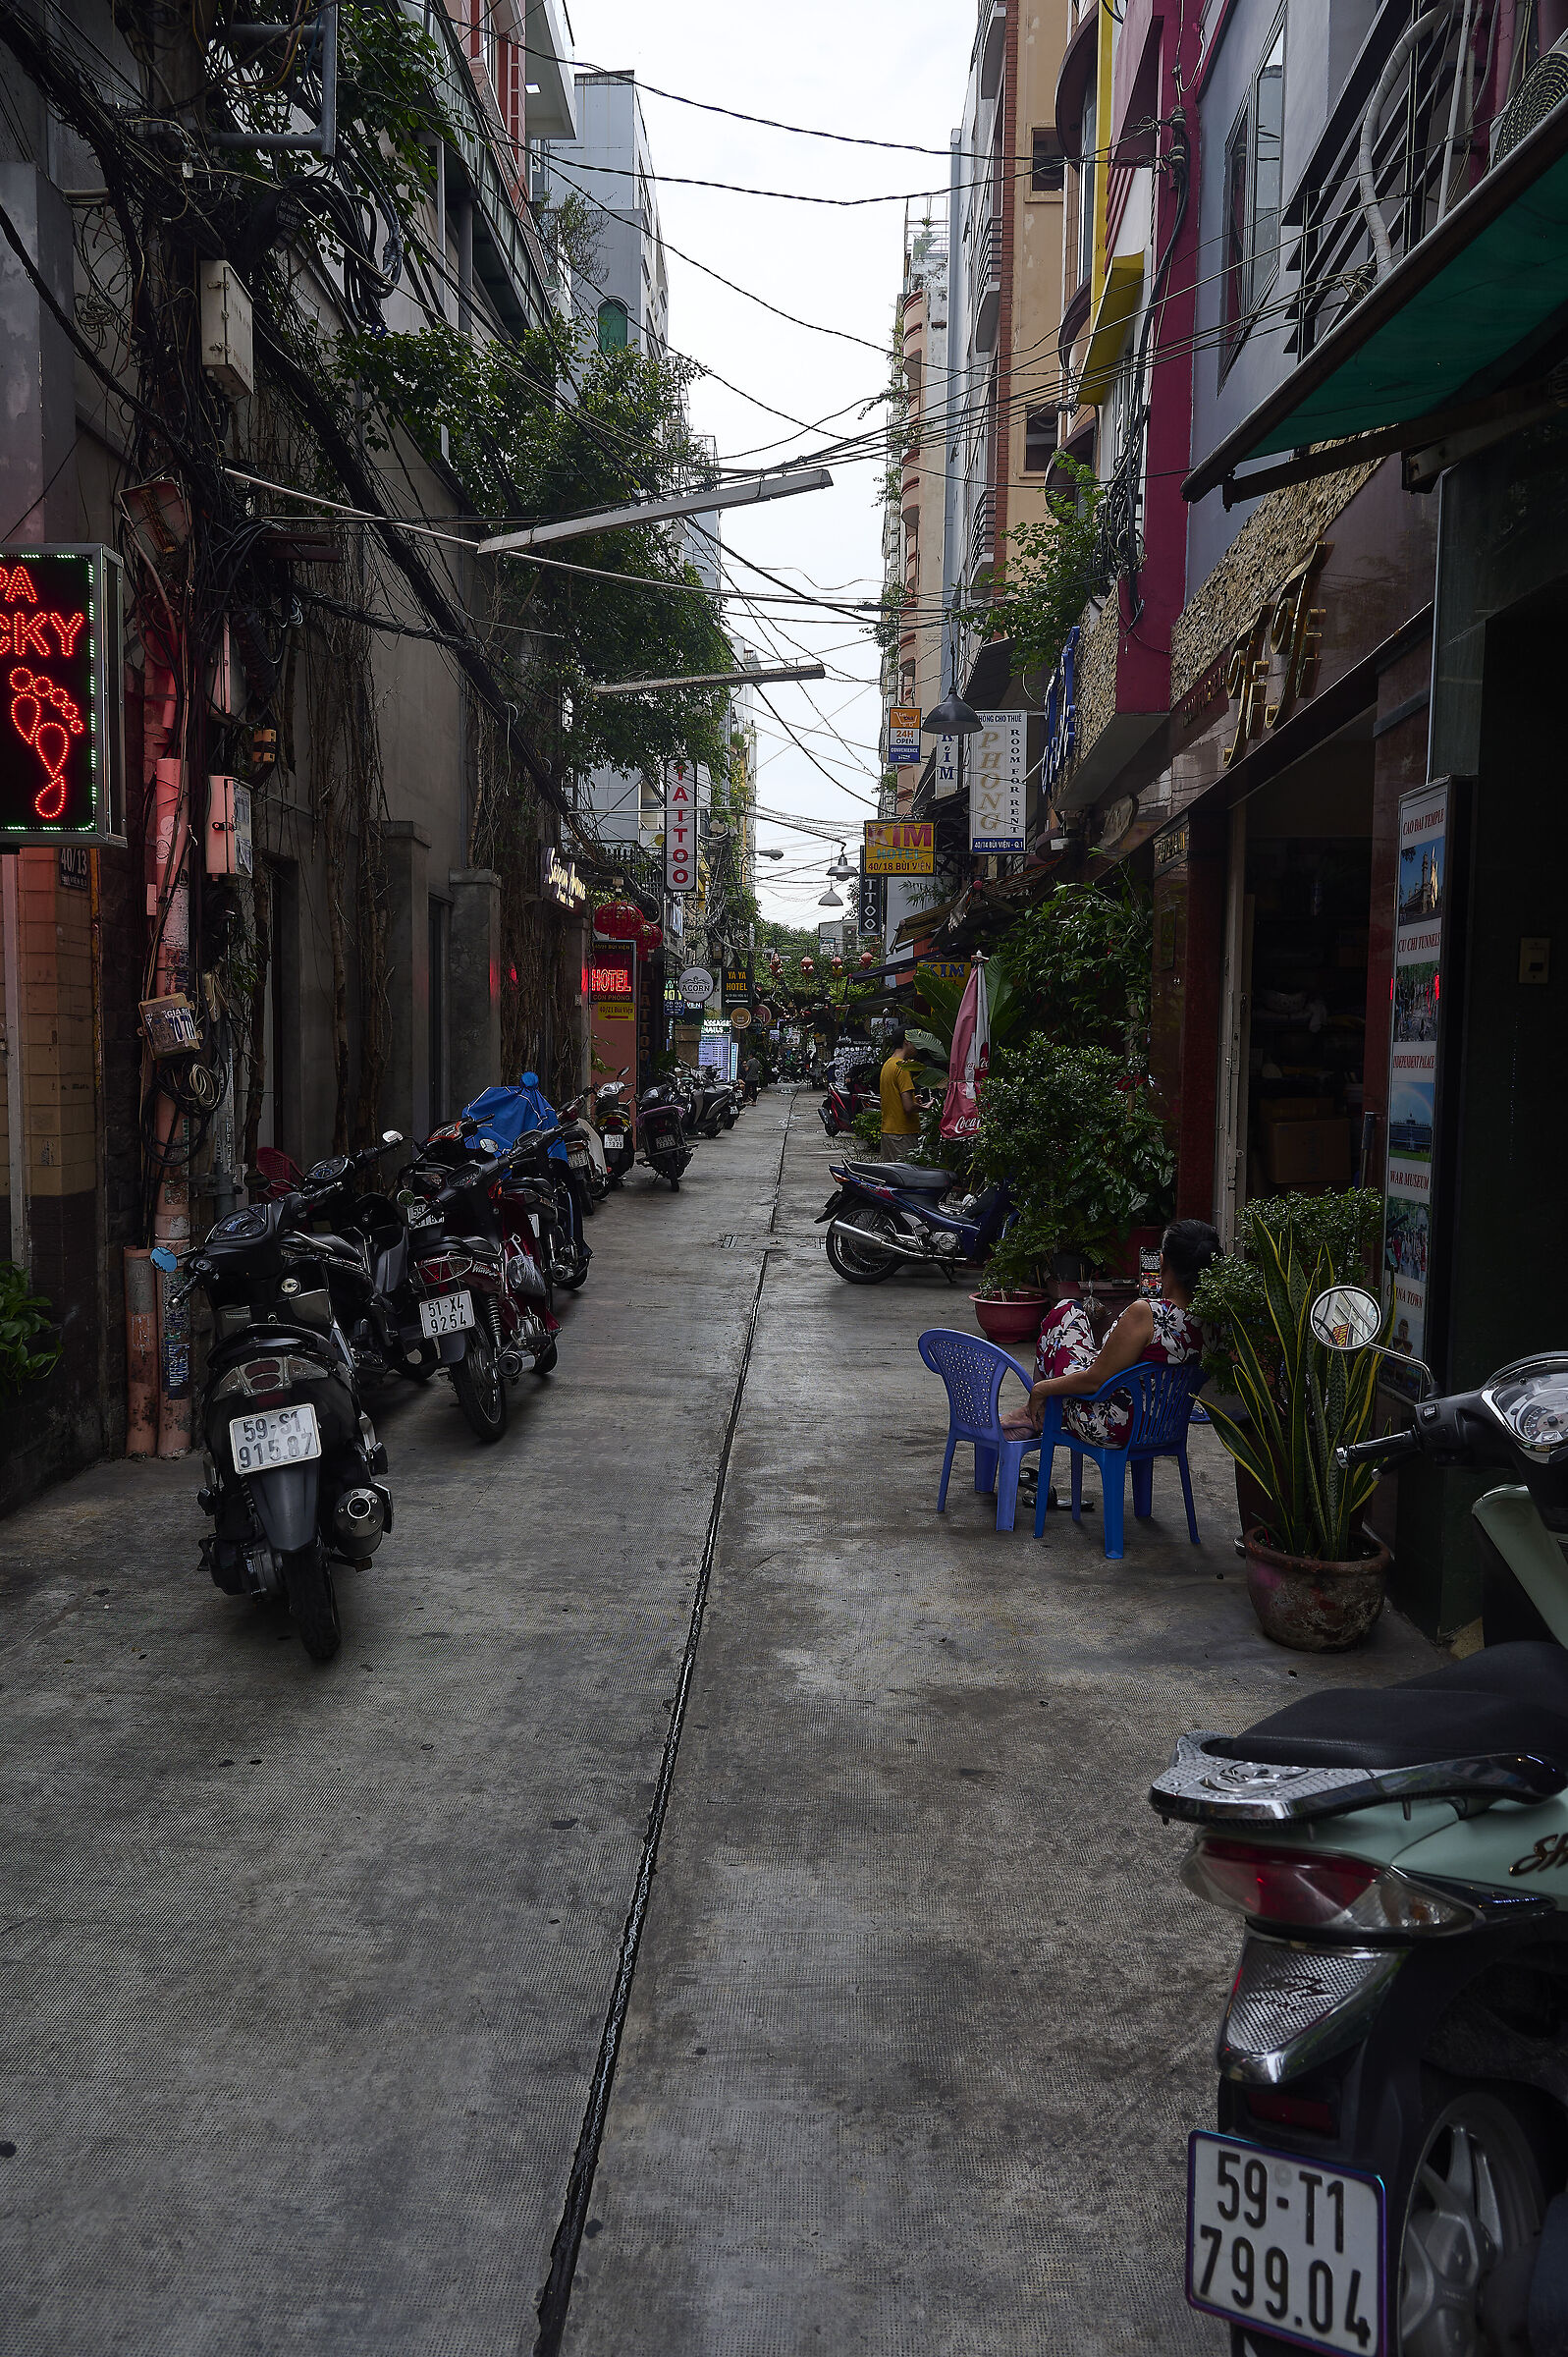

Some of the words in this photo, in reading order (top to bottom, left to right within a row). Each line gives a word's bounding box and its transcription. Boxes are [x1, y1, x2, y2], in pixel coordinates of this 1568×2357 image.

[979, 713, 995, 723] HÒNG
[996, 714, 1006, 723] CHO
[1010, 729, 1021, 763] ROOM
[1010, 768, 1020, 794] FOR
[1010, 799, 1020, 834] RENT
[1403, 820, 1414, 836] CAO
[1424, 808, 1444, 829] TEMPLE
[867, 824, 933, 848] KIM
[868, 861, 893, 871] 40/18
[895, 860, 910, 871] BÙI
[876, 848, 919, 860] HOTEL
[1398, 939, 1407, 953] CU
[1407, 937, 1418, 951] CHI
[591, 968, 632, 992] HOTEL
[726, 982, 748, 991] HOTEL
[728, 971, 736, 980] YA
[737, 971, 747, 980] YA
[1390, 1171, 1404, 1184] WAR
[1404, 1172, 1430, 1190] MUSEUM
[428, 1295, 464, 1318] 51-X4
[1386, 1284, 1406, 1304] CINA
[1407, 1290, 1424, 1308] TOWN
[430, 1309, 467, 1334] 9254
[243, 1410, 301, 1443] 59-S1
[239, 1432, 312, 1468] 915.87
[1217, 2149, 1344, 2254] 59-T1
[1200, 2224, 1371, 2349] 799.04
